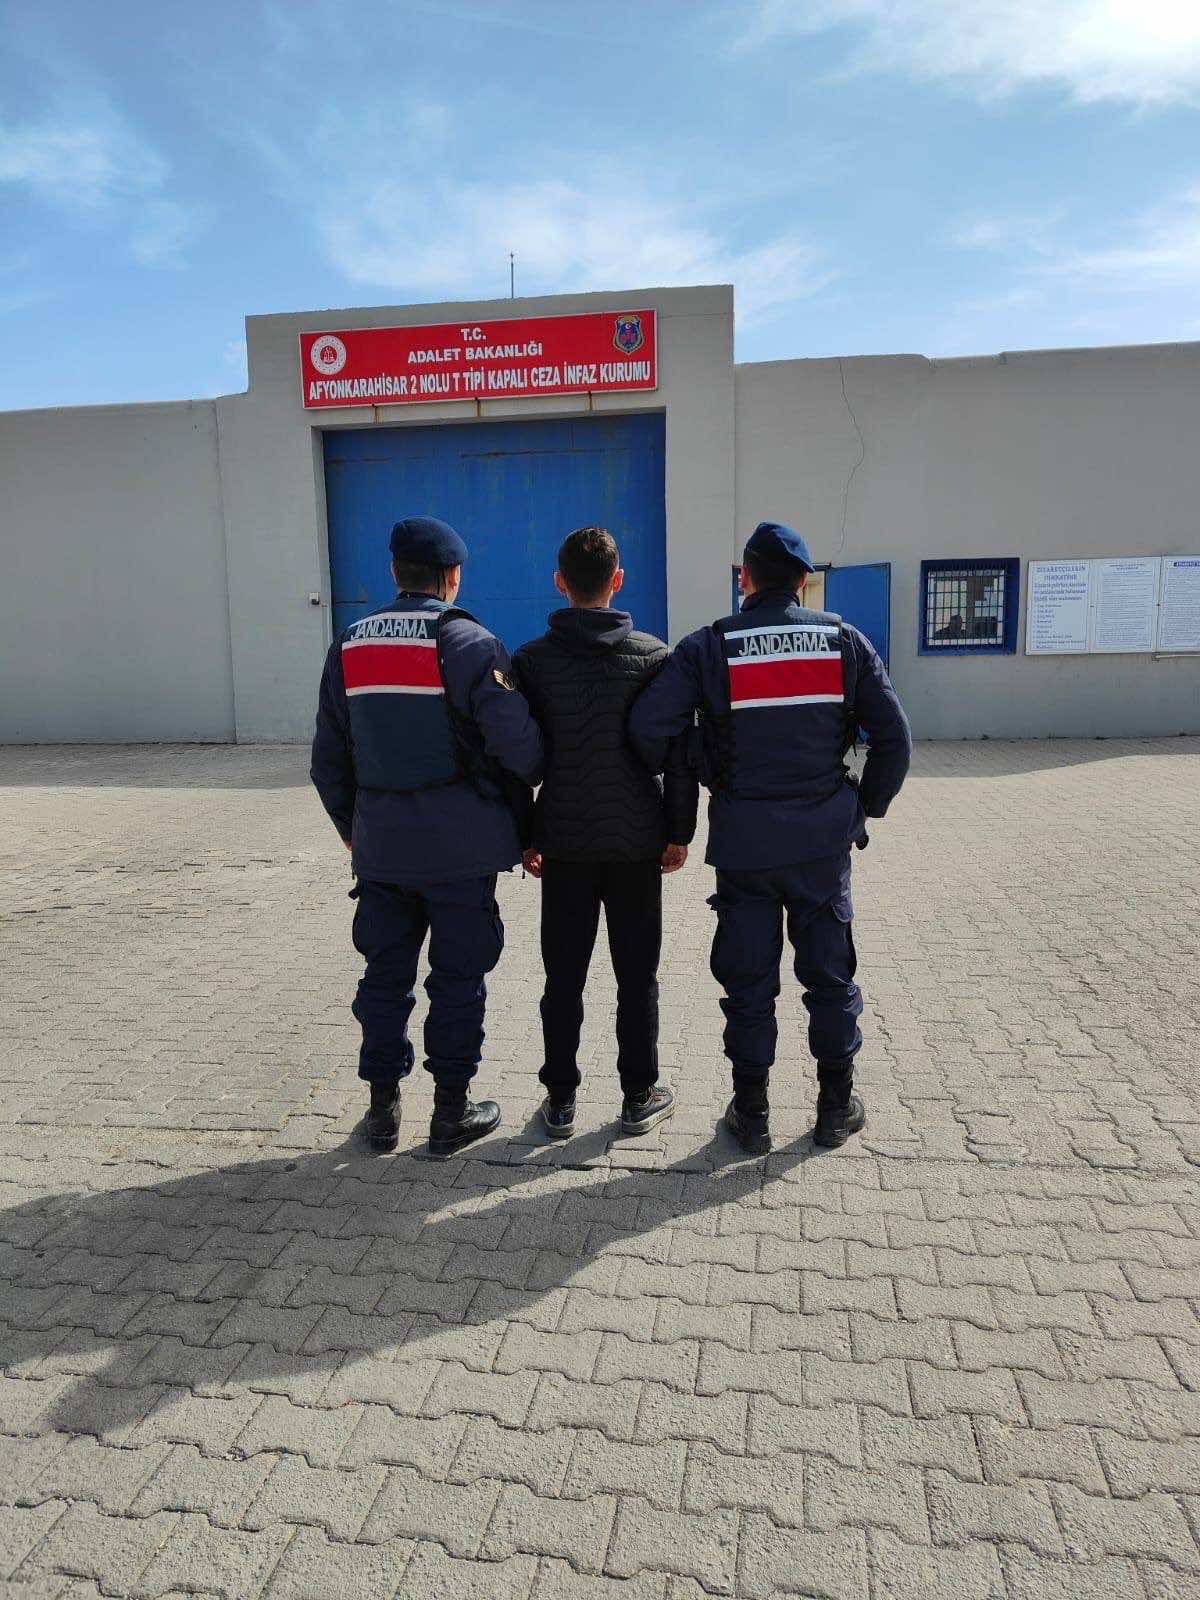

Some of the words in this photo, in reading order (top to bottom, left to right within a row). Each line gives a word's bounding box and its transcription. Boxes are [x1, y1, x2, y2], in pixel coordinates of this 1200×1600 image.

[460, 327, 487, 341] T.C.
[407, 348, 462, 364] ADALET
[465, 340, 543, 361] BAKANLIĞI
[309, 372, 409, 400] AFYONKARAHİSAR
[410, 374, 418, 395] 2
[420, 372, 450, 394] NOLU
[452, 372, 461, 392] T
[463, 366, 485, 391] TİPİ
[488, 368, 528, 390] KAPALI
[530, 366, 561, 388] CEZA
[564, 361, 598, 386] İNFAZ
[600, 360, 651, 384] KURUMU
[350, 618, 428, 640] JANDARMA
[738, 632, 831, 657] JANDARMA
